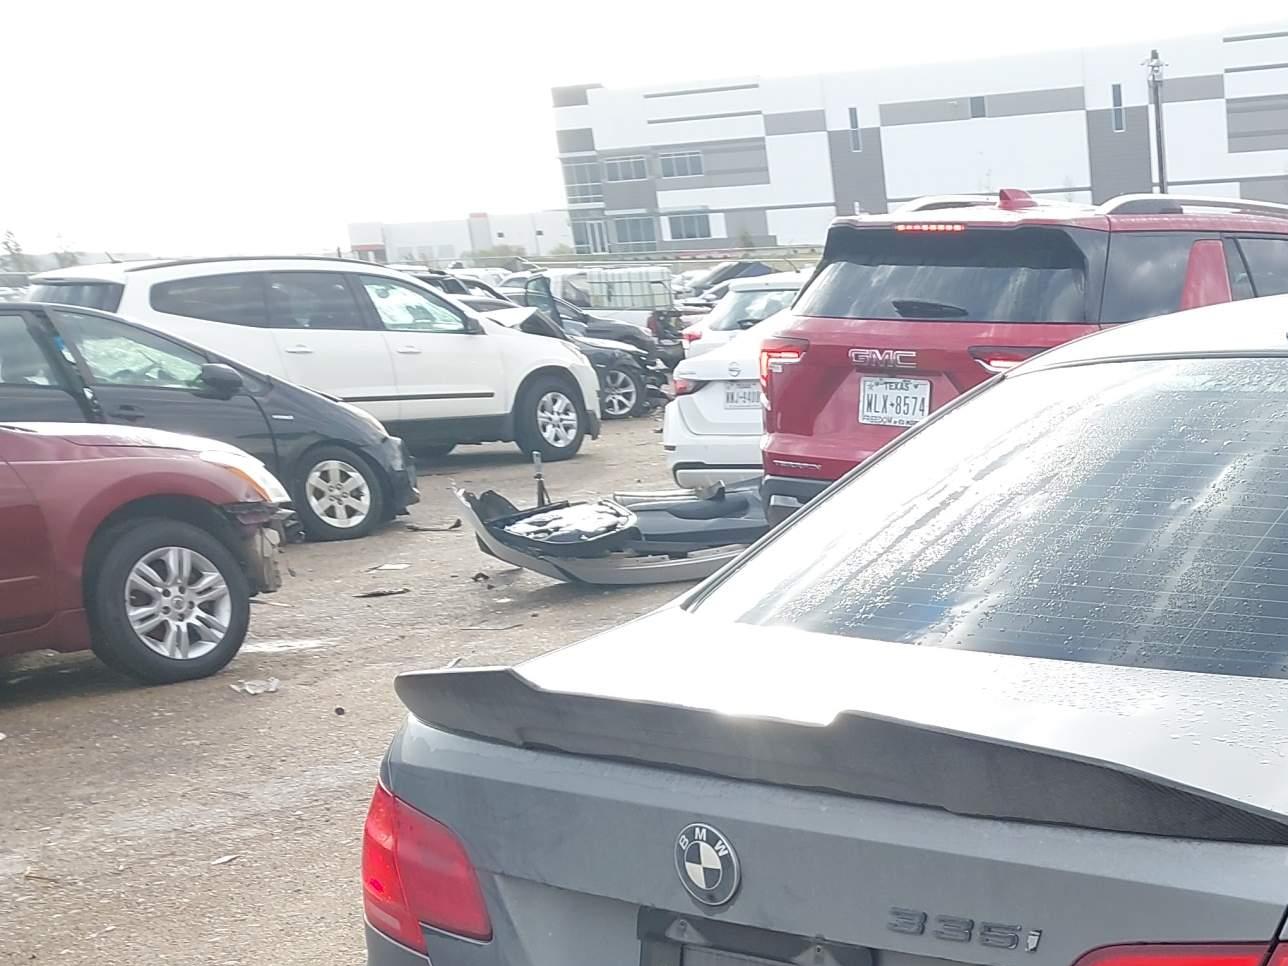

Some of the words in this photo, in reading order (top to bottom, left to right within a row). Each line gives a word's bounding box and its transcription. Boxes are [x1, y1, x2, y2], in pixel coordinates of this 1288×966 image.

[848, 348, 917, 369] GMC
[884, 382, 910, 392] TEXAS
[679, 827, 729, 857] BMW
[886, 907, 1043, 953] 335i
